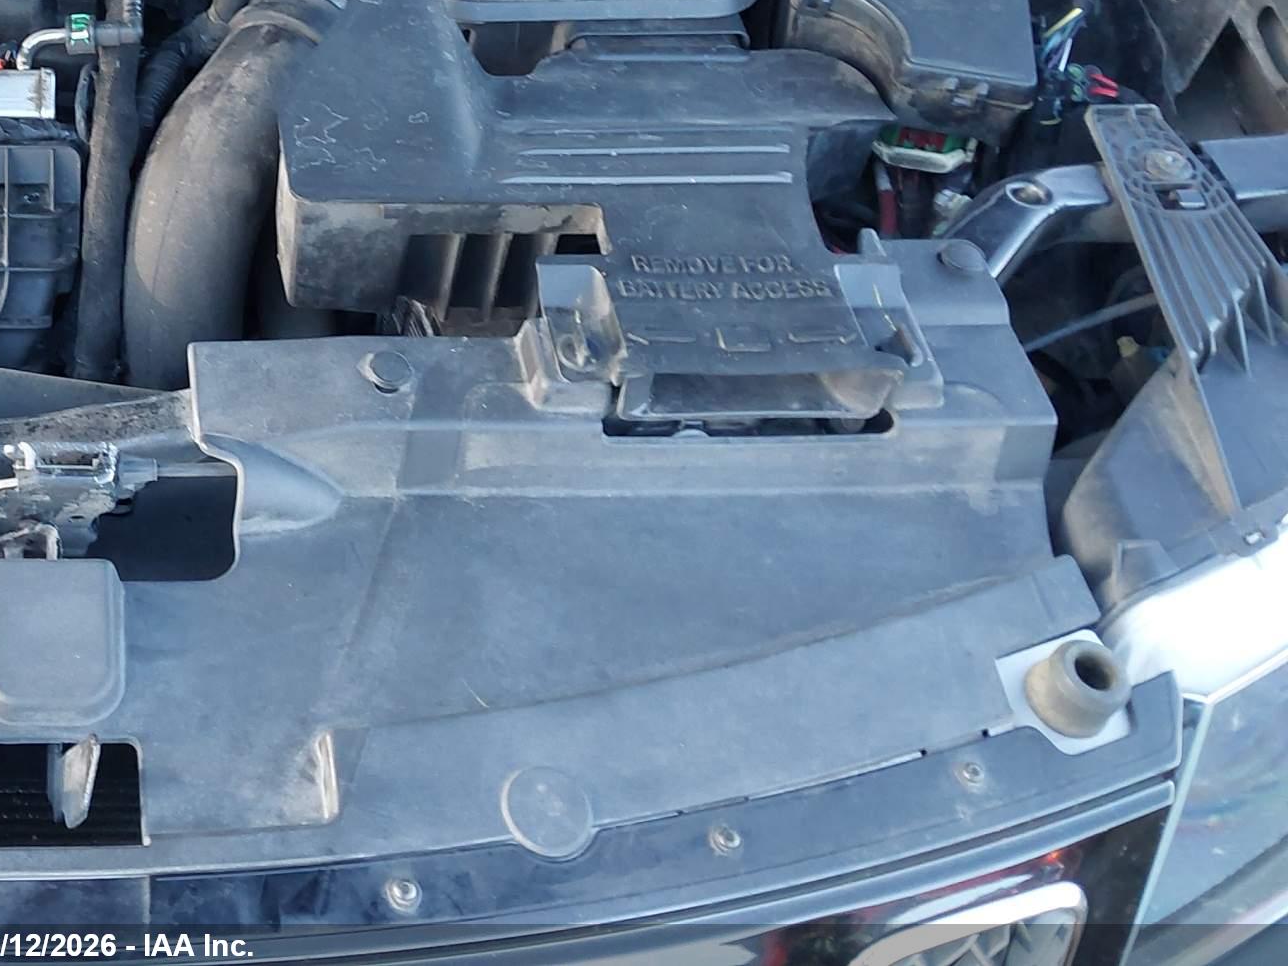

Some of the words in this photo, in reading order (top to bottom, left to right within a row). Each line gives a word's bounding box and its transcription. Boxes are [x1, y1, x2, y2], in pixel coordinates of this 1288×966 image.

[631, 254, 738, 274] REMOVE
[738, 255, 794, 274] FOR
[616, 279, 722, 300] BATTERY
[730, 280, 833, 300] ACCESS
